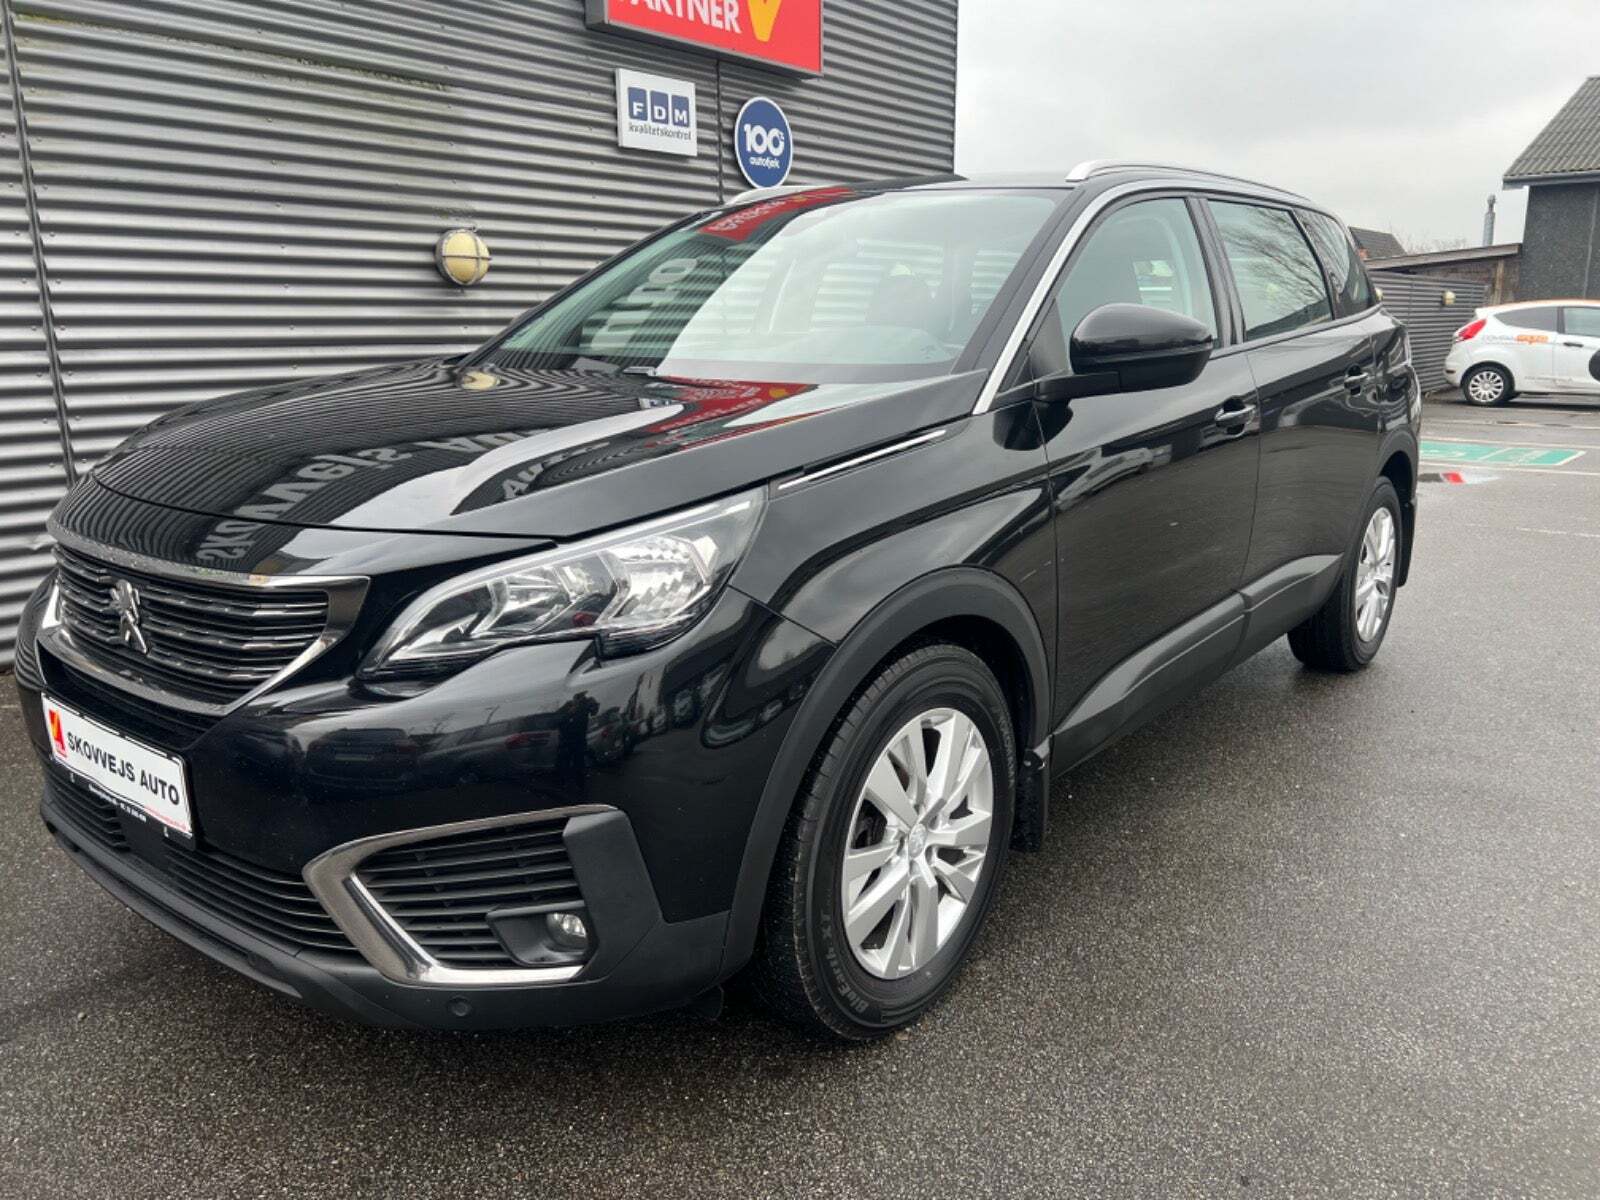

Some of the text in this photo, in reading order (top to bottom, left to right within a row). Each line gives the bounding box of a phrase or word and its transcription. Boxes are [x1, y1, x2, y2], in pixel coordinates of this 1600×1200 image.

[628, 0, 742, 34] TNER
[632, 101, 689, 125] FDM
[628, 122, 692, 141] kvalitetskontrol
[66, 731, 136, 783] SKOVVEJS
[139, 769, 181, 806] AUTO
